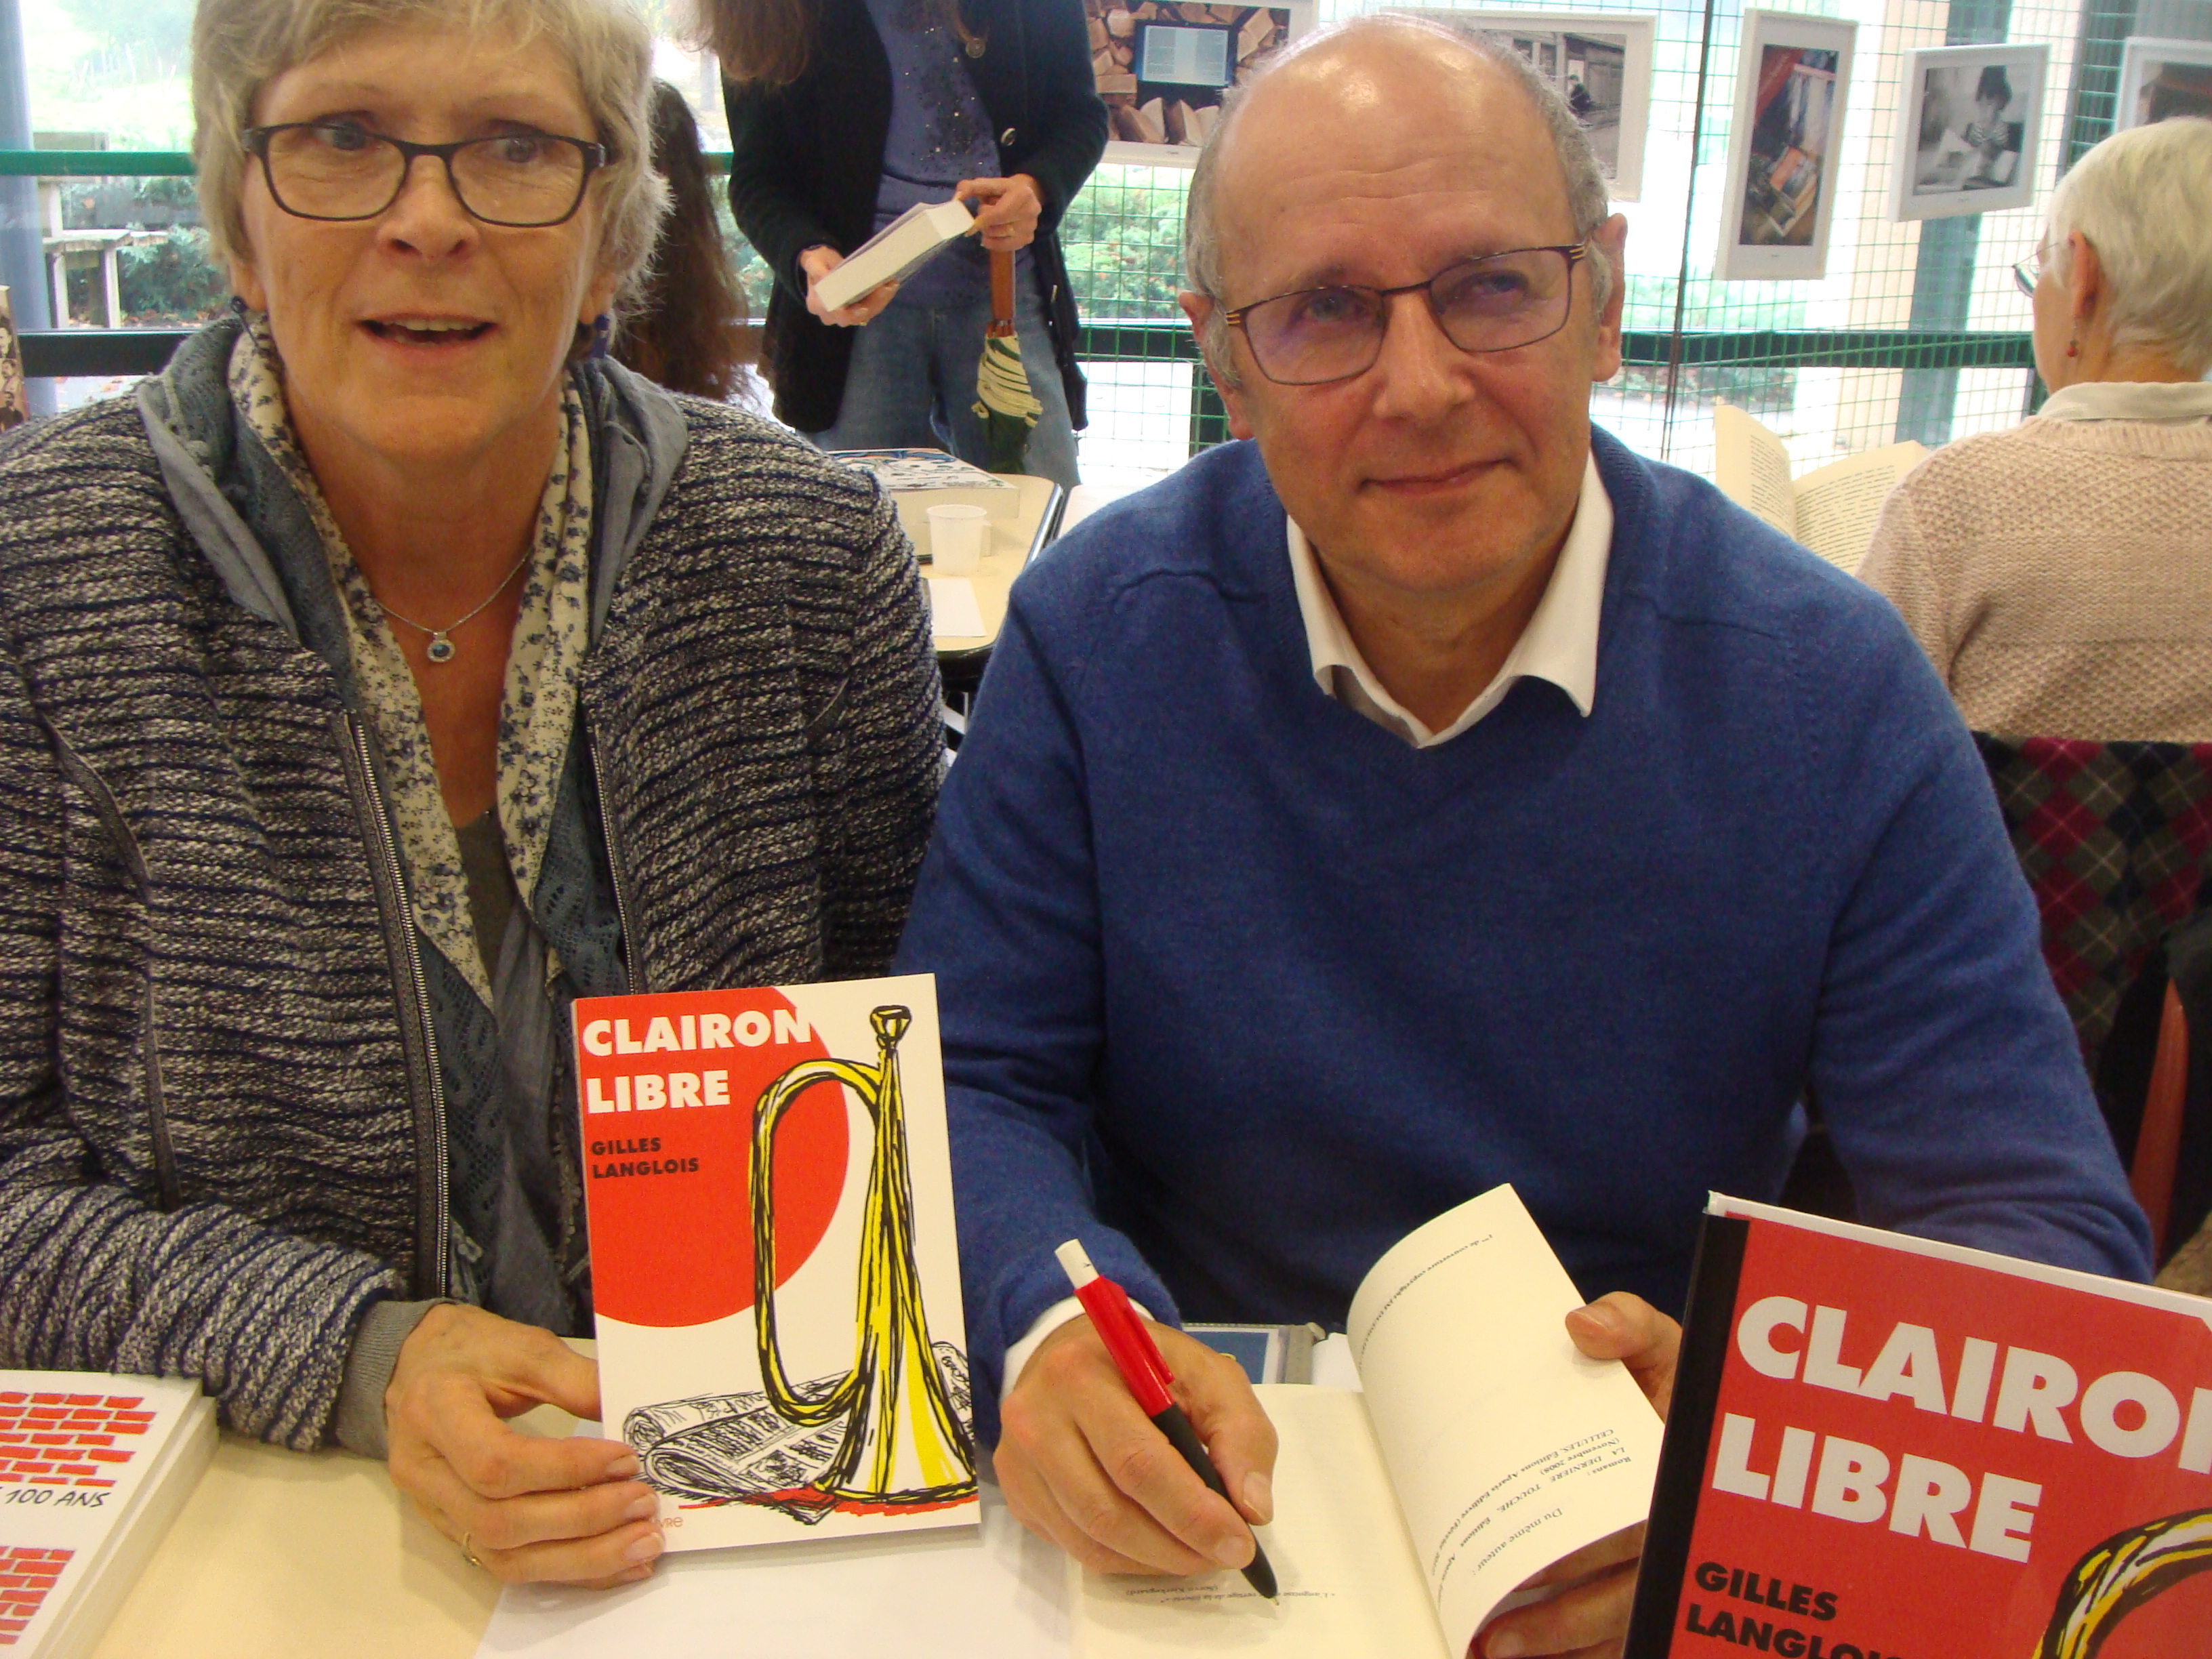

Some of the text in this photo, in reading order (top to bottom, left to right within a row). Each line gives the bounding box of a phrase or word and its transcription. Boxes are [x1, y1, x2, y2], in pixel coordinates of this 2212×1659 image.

[582, 1008, 812, 1057] CLAIRON
[586, 1069, 731, 1114] LIBRE
[590, 1137, 662, 1156] GILLES
[592, 1158, 701, 1181] LANGLOIS
[1567, 1437, 1620, 1462] (Novembre
[5, 1488, 111, 1508] 100 ANS
[1711, 1412, 2043, 1564] LIBRE
[1543, 1508, 1563, 1521] Du
[1509, 1518, 1542, 1542] même
[1695, 1561, 1839, 1622] GILLES
